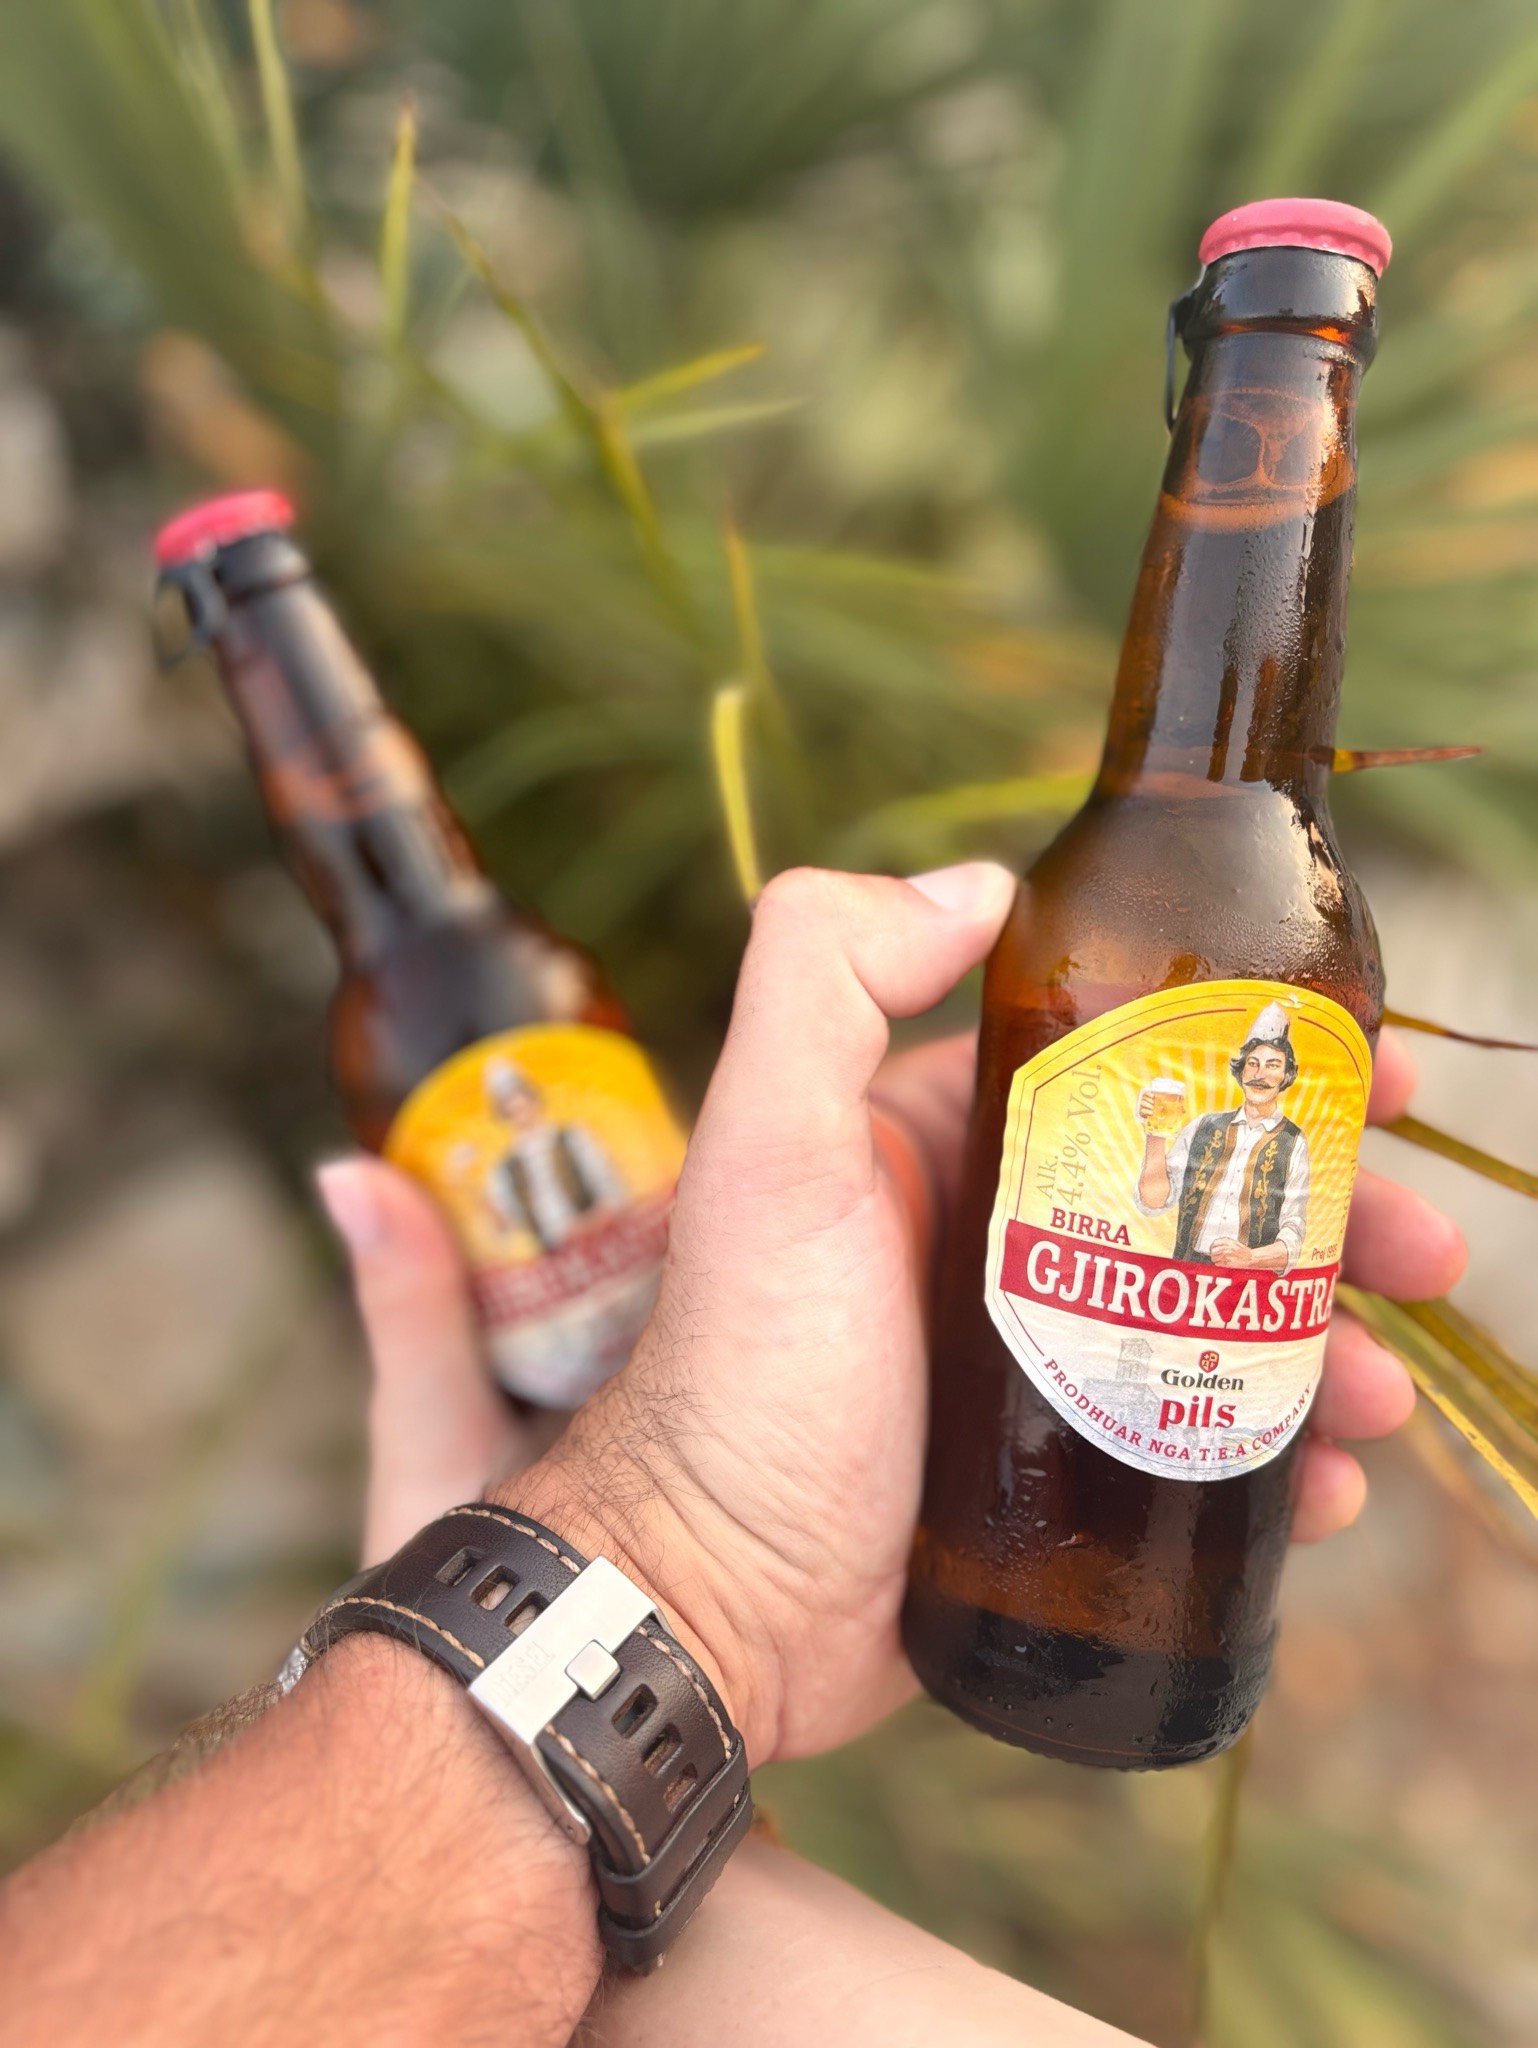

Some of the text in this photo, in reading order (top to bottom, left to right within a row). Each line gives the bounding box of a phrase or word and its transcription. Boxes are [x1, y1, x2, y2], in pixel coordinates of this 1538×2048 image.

[1056, 1064, 1102, 1206] 4.4% Vol.
[1036, 1155, 1059, 1200] Alk.
[1050, 1207, 1132, 1247] BIRRA
[1160, 1368, 1244, 1391] Golden
[1044, 1359, 1311, 1462] PRODHUAR NGA T.E.A COMPANY
[1157, 1395, 1237, 1430] pils
